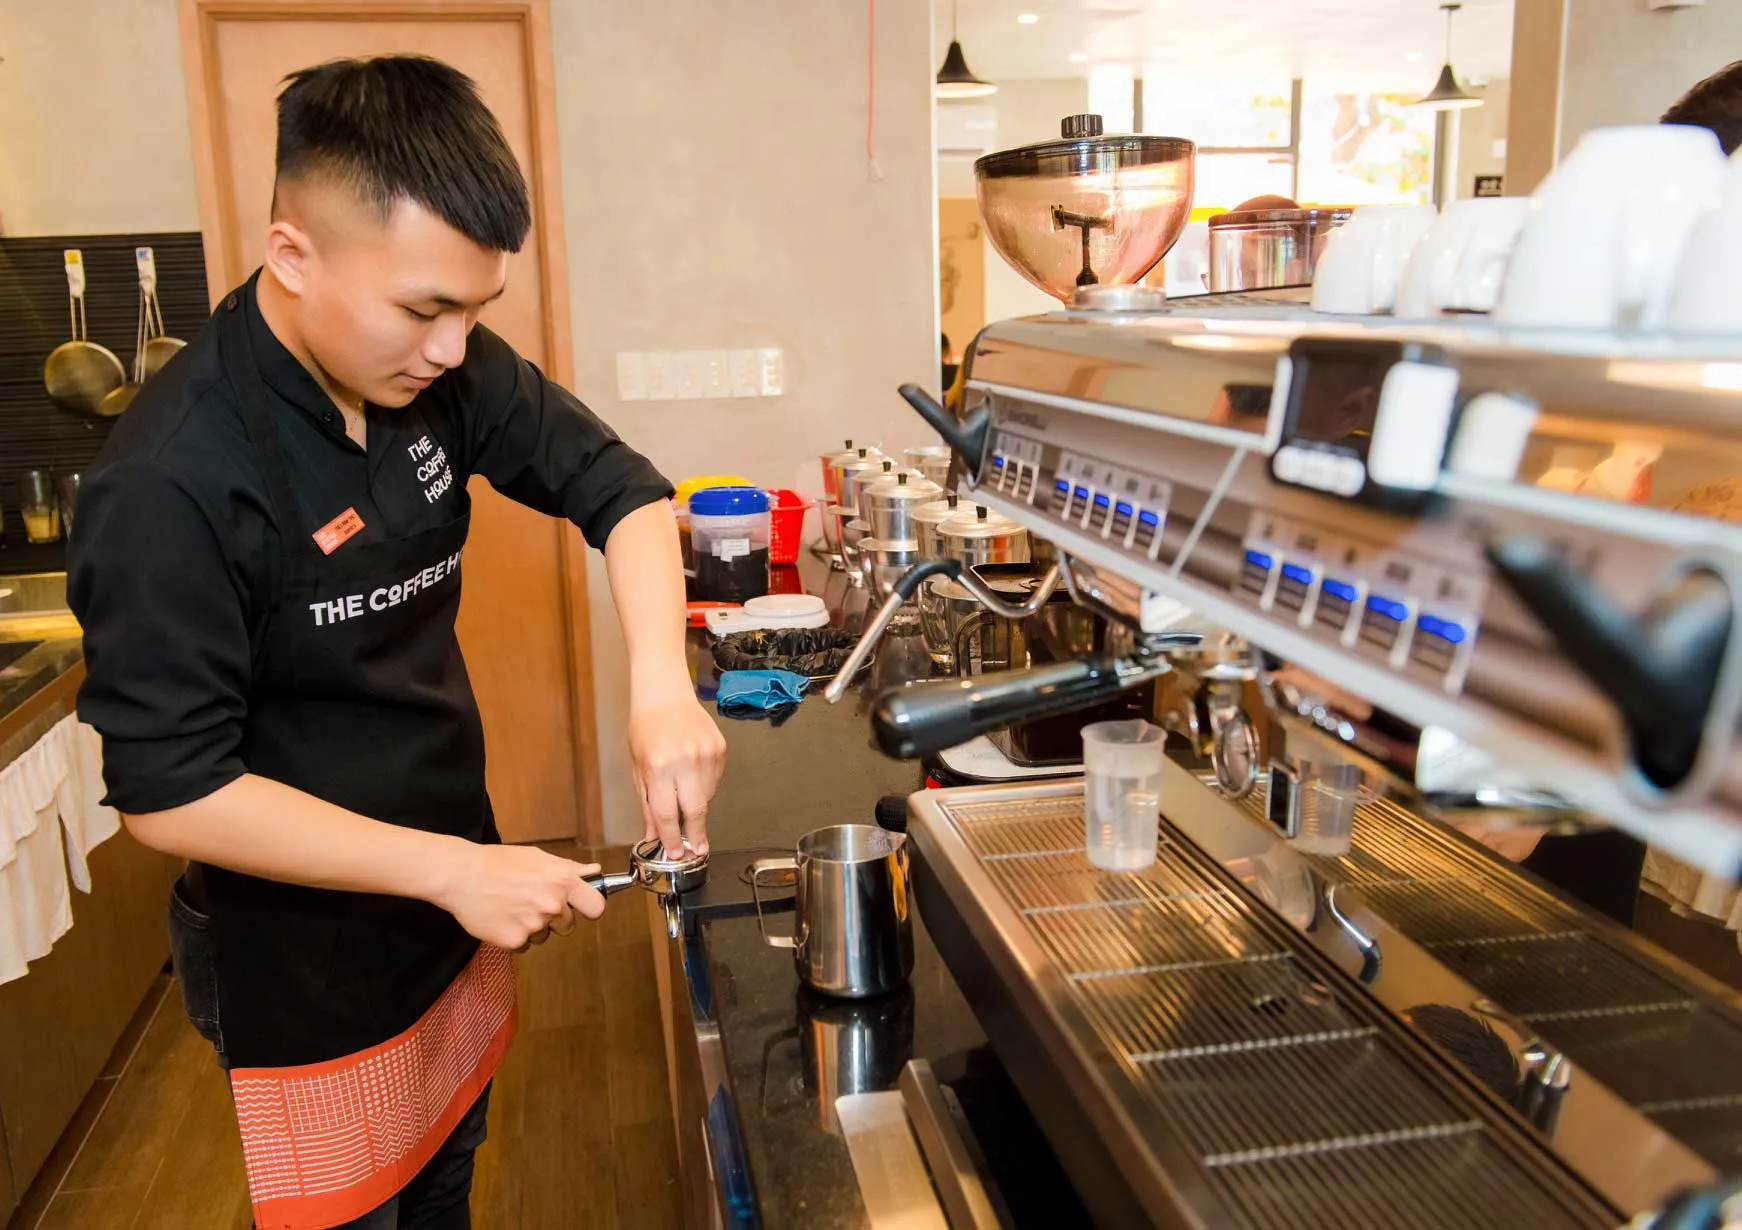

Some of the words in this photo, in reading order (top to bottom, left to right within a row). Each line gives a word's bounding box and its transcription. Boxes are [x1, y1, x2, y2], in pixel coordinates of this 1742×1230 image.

[408, 435, 433, 462] THE
[309, 594, 364, 626] THE
[369, 560, 446, 611] COFFEE
